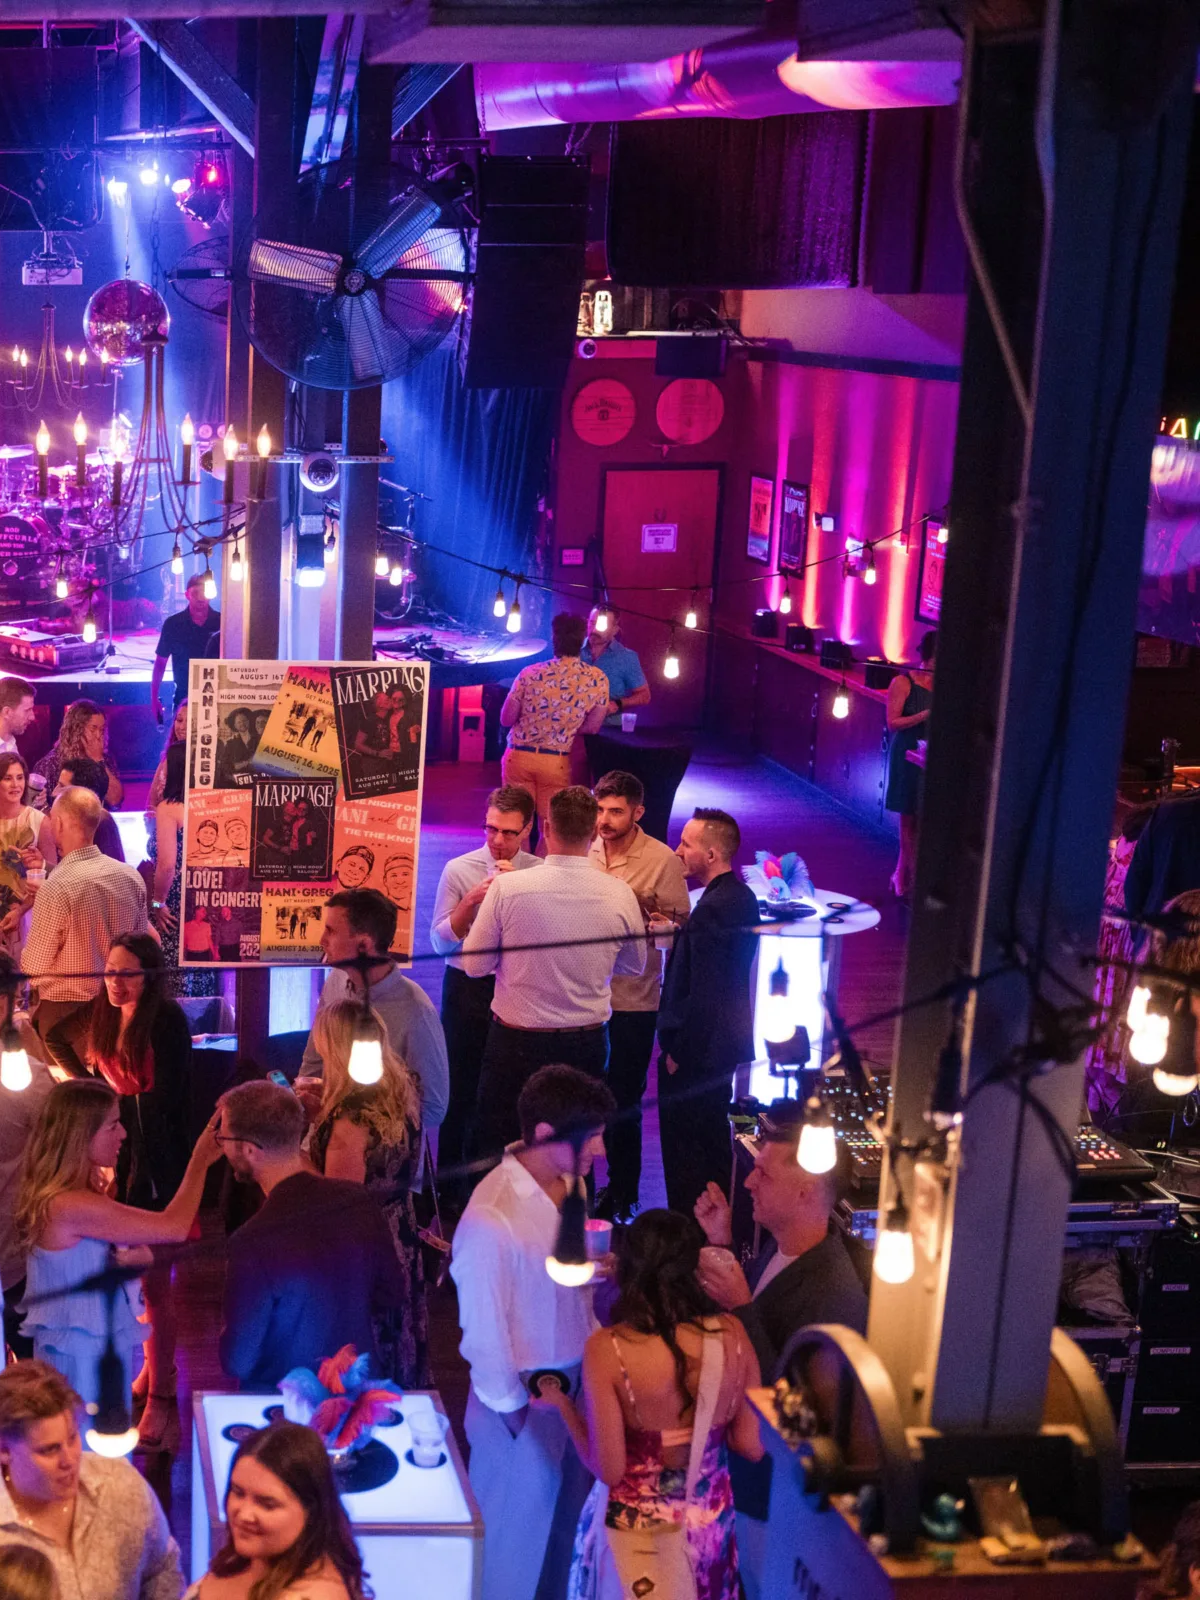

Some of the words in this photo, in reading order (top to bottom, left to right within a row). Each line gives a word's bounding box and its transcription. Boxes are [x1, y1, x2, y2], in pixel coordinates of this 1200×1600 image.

[288, 672, 326, 694] HANI
[202, 668, 214, 720] HANI
[199, 734, 212, 785] GREG
[263, 746, 302, 763] AUGUST
[316, 763, 340, 777] 2025
[355, 773, 390, 783] SATURDAY
[255, 784, 334, 807] MARRIAGE
[368, 799, 401, 810] NIGHT
[344, 827, 362, 837] TIE
[363, 830, 386, 840] THE
[186, 870, 223, 889] LOVE!
[195, 891, 208, 907] IN
[266, 888, 296, 897] HANI
[302, 888, 334, 897] GREG
